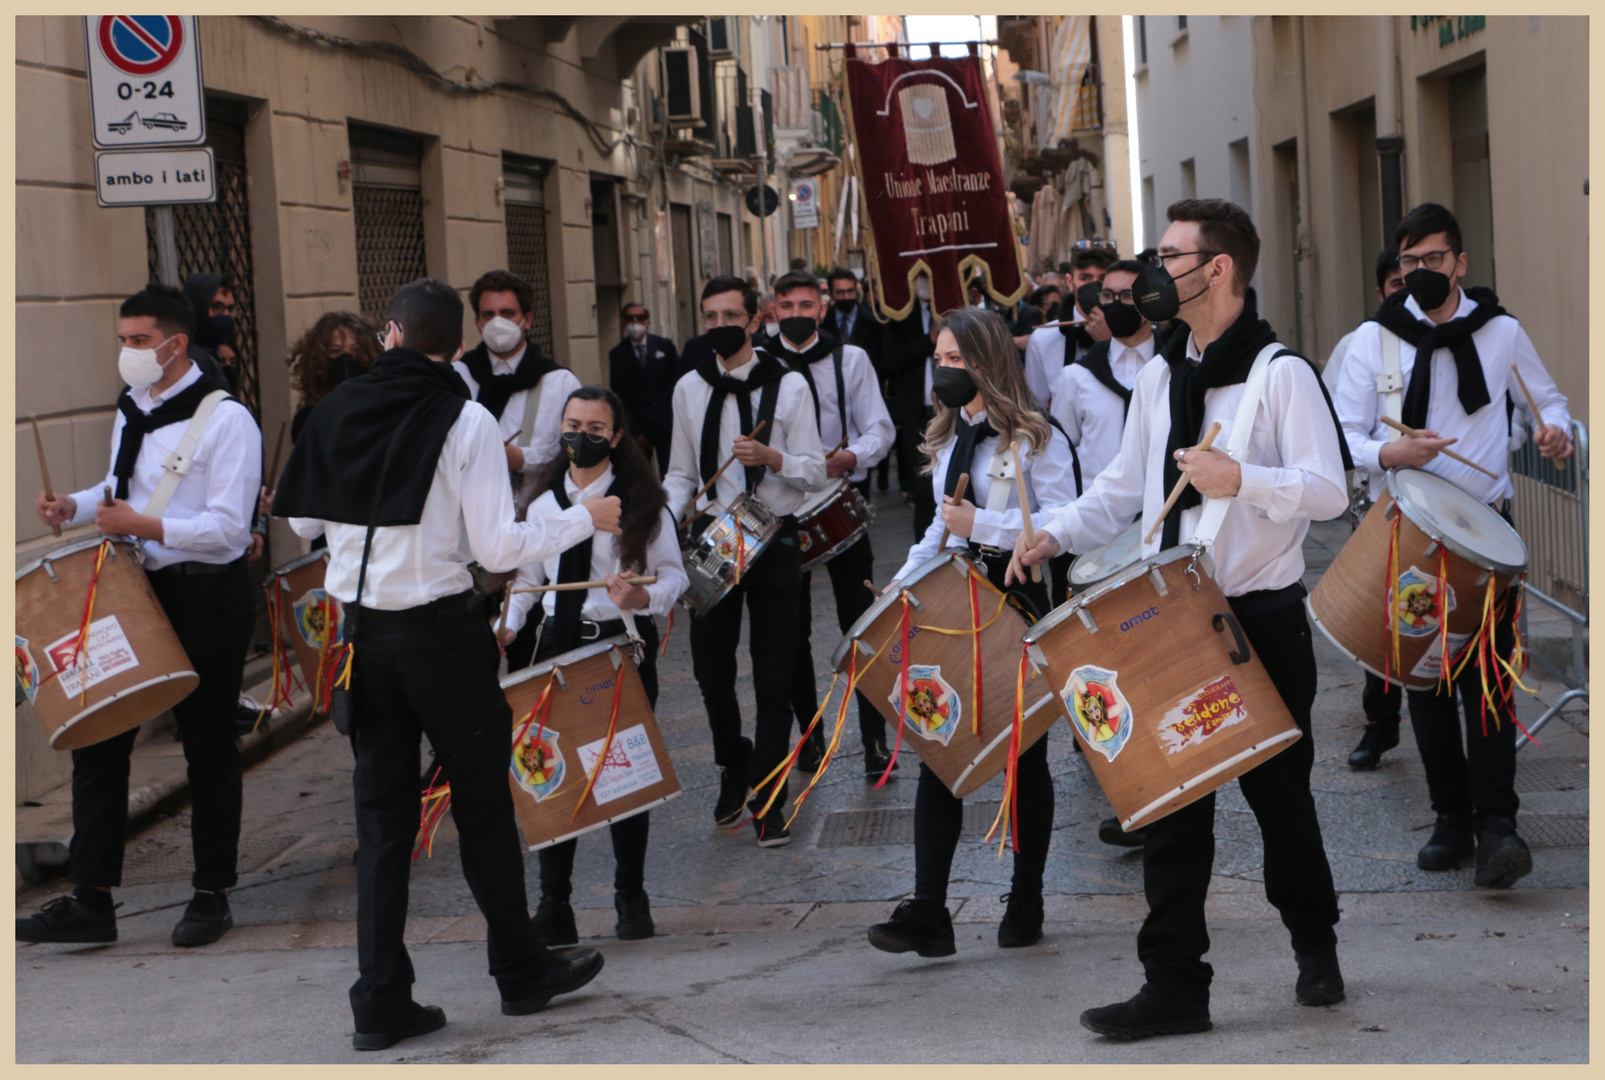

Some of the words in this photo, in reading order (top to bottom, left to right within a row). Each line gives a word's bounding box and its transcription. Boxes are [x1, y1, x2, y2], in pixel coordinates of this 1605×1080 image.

[117, 80, 175, 101] 0-24
[106, 171, 154, 185] ambo
[162, 170, 168, 184] i
[176, 169, 206, 183] lati
[884, 171, 922, 199] Unione
[925, 166, 991, 195] Maestranze
[911, 200, 969, 243] Trapani
[1119, 605, 1161, 632] amat
[626, 733, 647, 750] B&B
